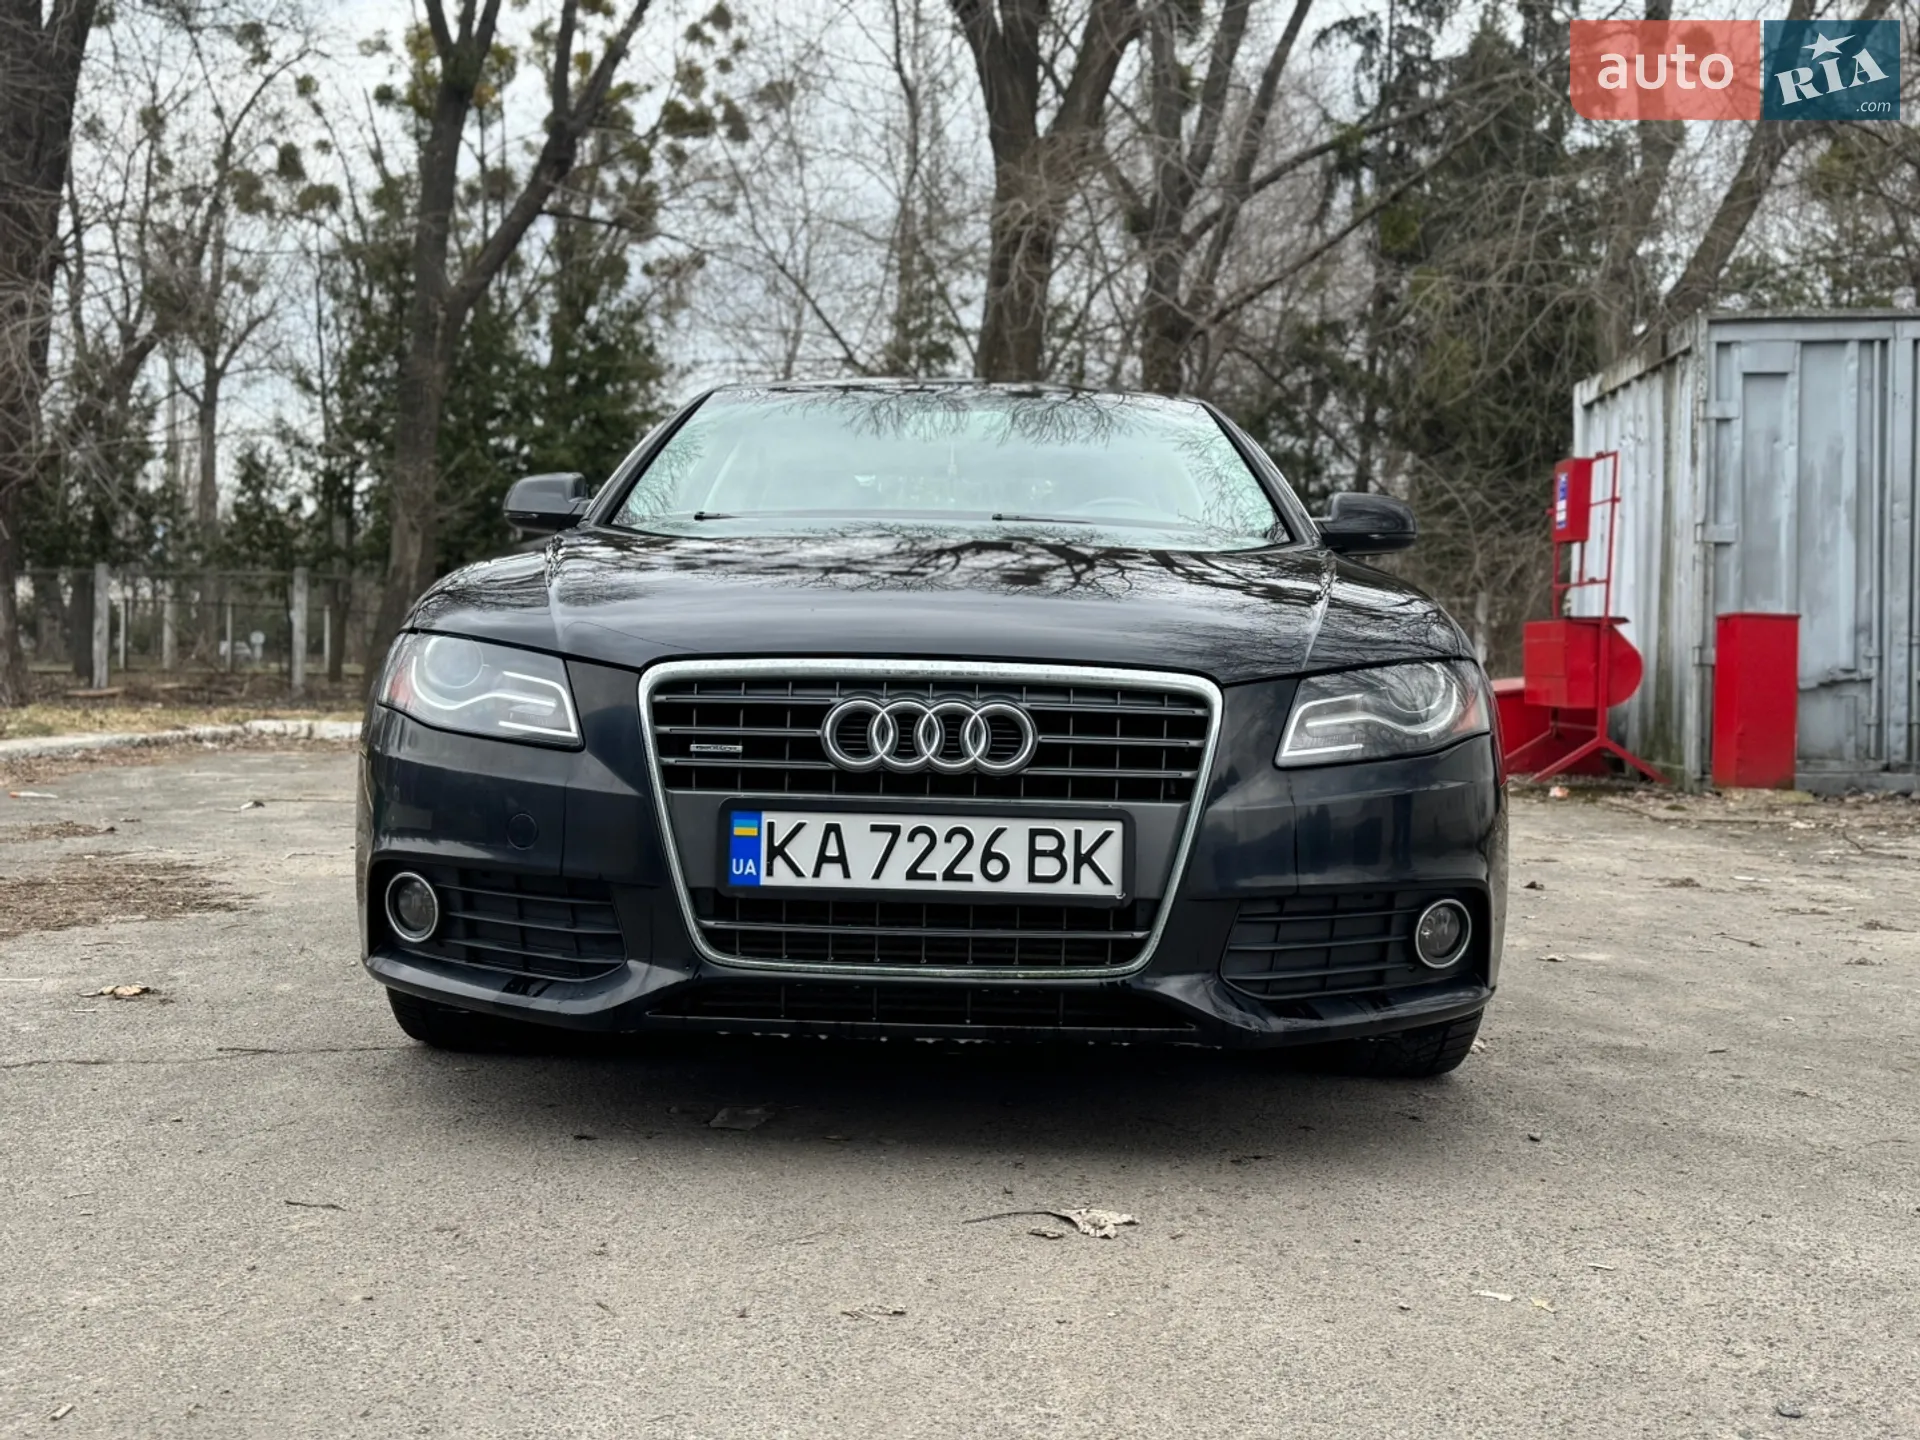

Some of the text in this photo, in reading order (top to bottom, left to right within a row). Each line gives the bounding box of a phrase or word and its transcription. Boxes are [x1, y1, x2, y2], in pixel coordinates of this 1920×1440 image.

[731, 858, 757, 876] UA
[765, 820, 1116, 886] KA 7226 BK
